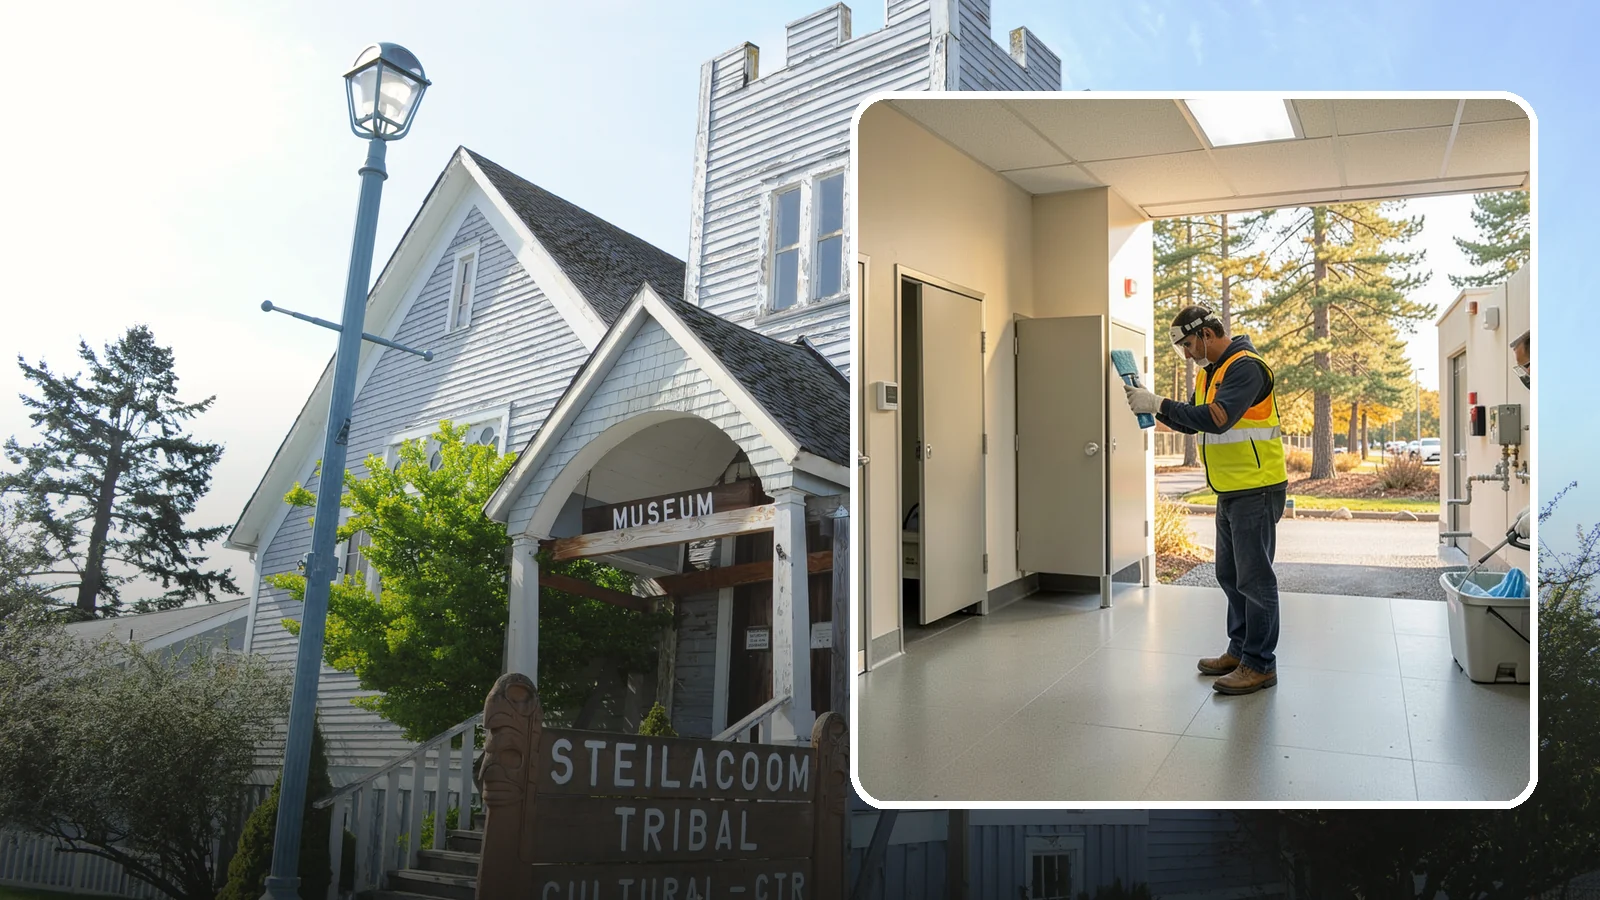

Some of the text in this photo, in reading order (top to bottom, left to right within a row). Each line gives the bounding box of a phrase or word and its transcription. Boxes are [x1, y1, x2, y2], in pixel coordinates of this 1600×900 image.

[612, 491, 714, 531] MUSEUM
[550, 738, 809, 793] STEILACOOM
[614, 806, 757, 852] TRIBAL
